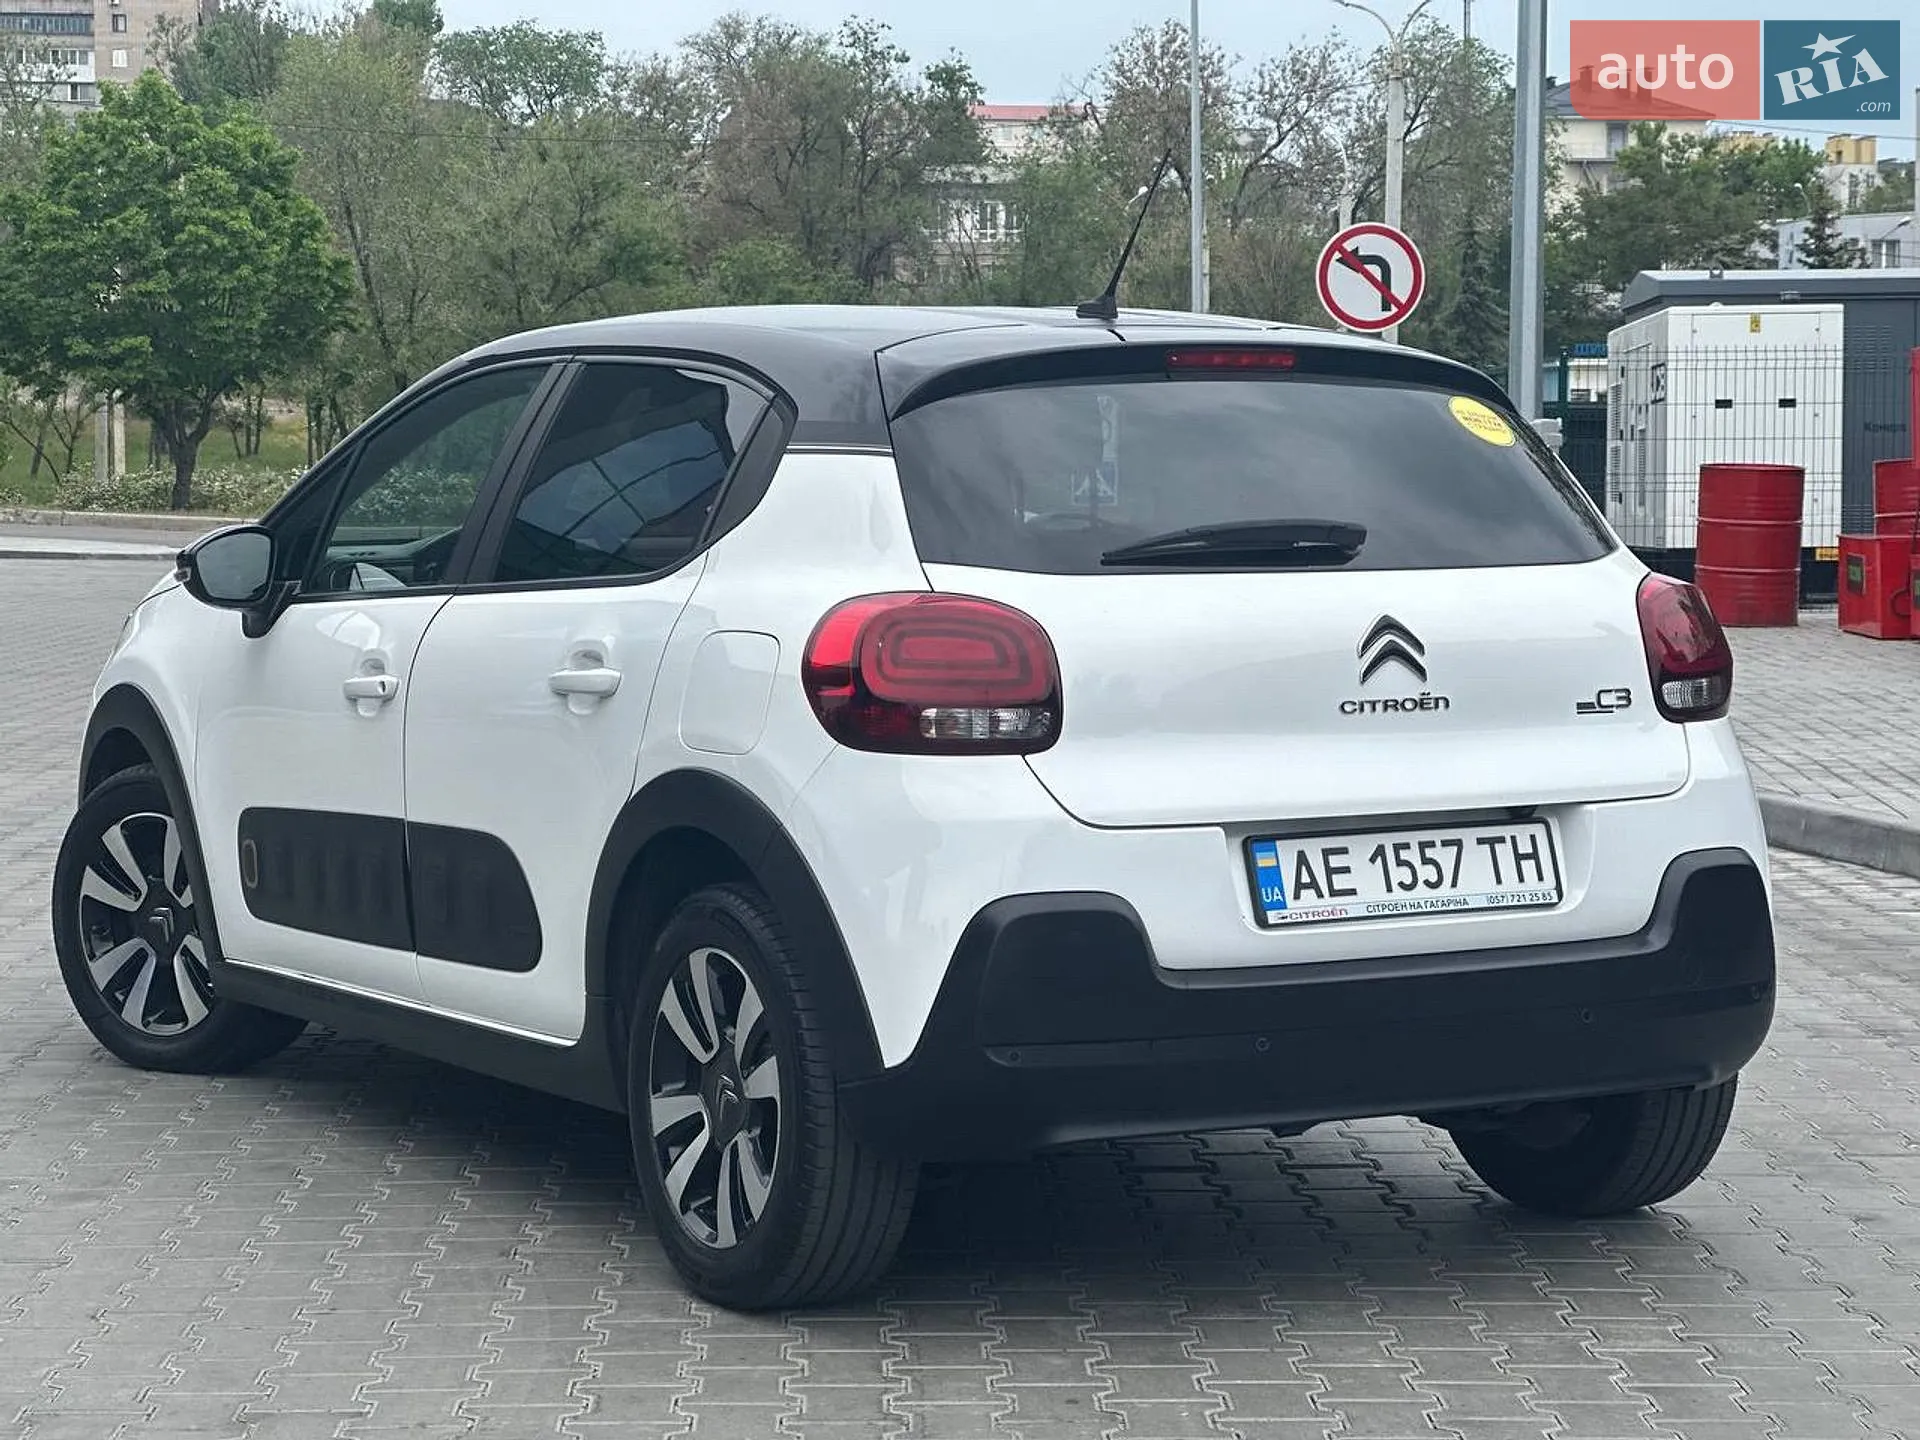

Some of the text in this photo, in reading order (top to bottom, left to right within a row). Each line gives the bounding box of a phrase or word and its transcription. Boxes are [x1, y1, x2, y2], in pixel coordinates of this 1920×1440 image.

[1596, 688, 1632, 709] C3
[1292, 833, 1545, 901] AE 1557 TH
[1261, 886, 1284, 904] UA
[1510, 893, 1527, 903] 721
[1529, 892, 1541, 903] 25
